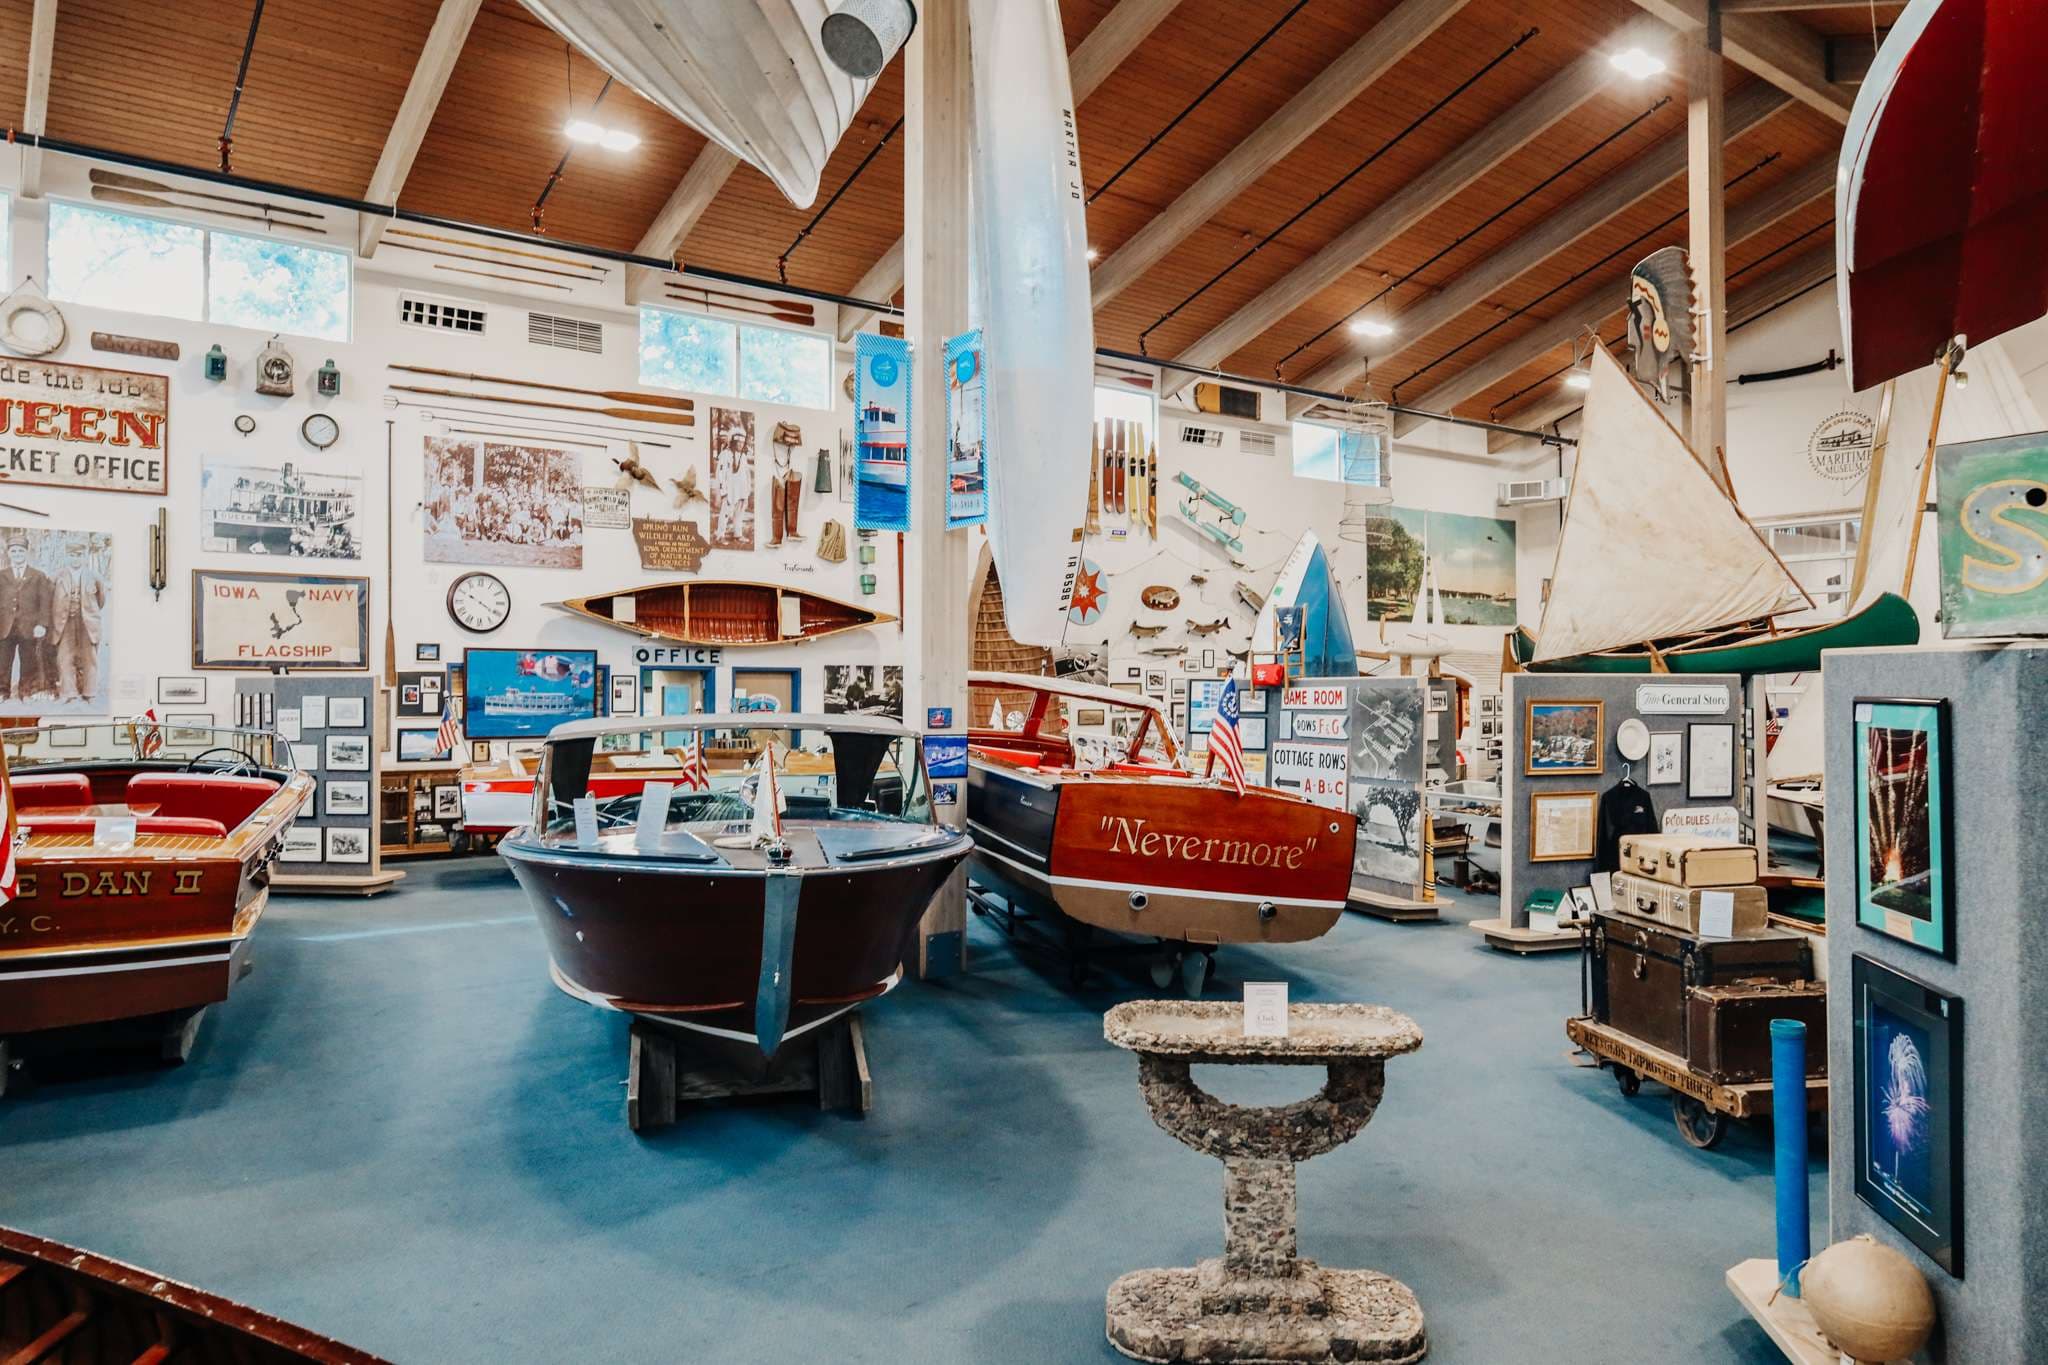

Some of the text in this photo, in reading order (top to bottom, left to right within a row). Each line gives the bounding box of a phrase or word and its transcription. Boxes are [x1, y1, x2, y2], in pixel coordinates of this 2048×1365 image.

[43, 367, 84, 390] the
[74, 453, 160, 482] OFFICE
[642, 523, 689, 533] SPRING RUN
[639, 532, 696, 542] WILDLIFE AREA
[663, 546, 704, 554] DEPARTMENT
[652, 559, 690, 567] RESOURCES
[214, 584, 354, 601] IOWA NAVY
[238, 645, 333, 657] FLAGSHIP
[635, 648, 721, 664] OFFICE
[1314, 690, 1343, 705] ROOM
[1662, 693, 1701, 705] General
[1703, 693, 1727, 705] Store
[1274, 749, 1314, 768] COTTAGE
[1319, 753, 1346, 771] ROWS
[1685, 814, 1710, 826] RULES
[1101, 815, 1318, 870] "Nevermore"
[62, 870, 152, 897] DAN
[173, 870, 204, 894] II
[1678, 1071, 1714, 1101] TRUCK
